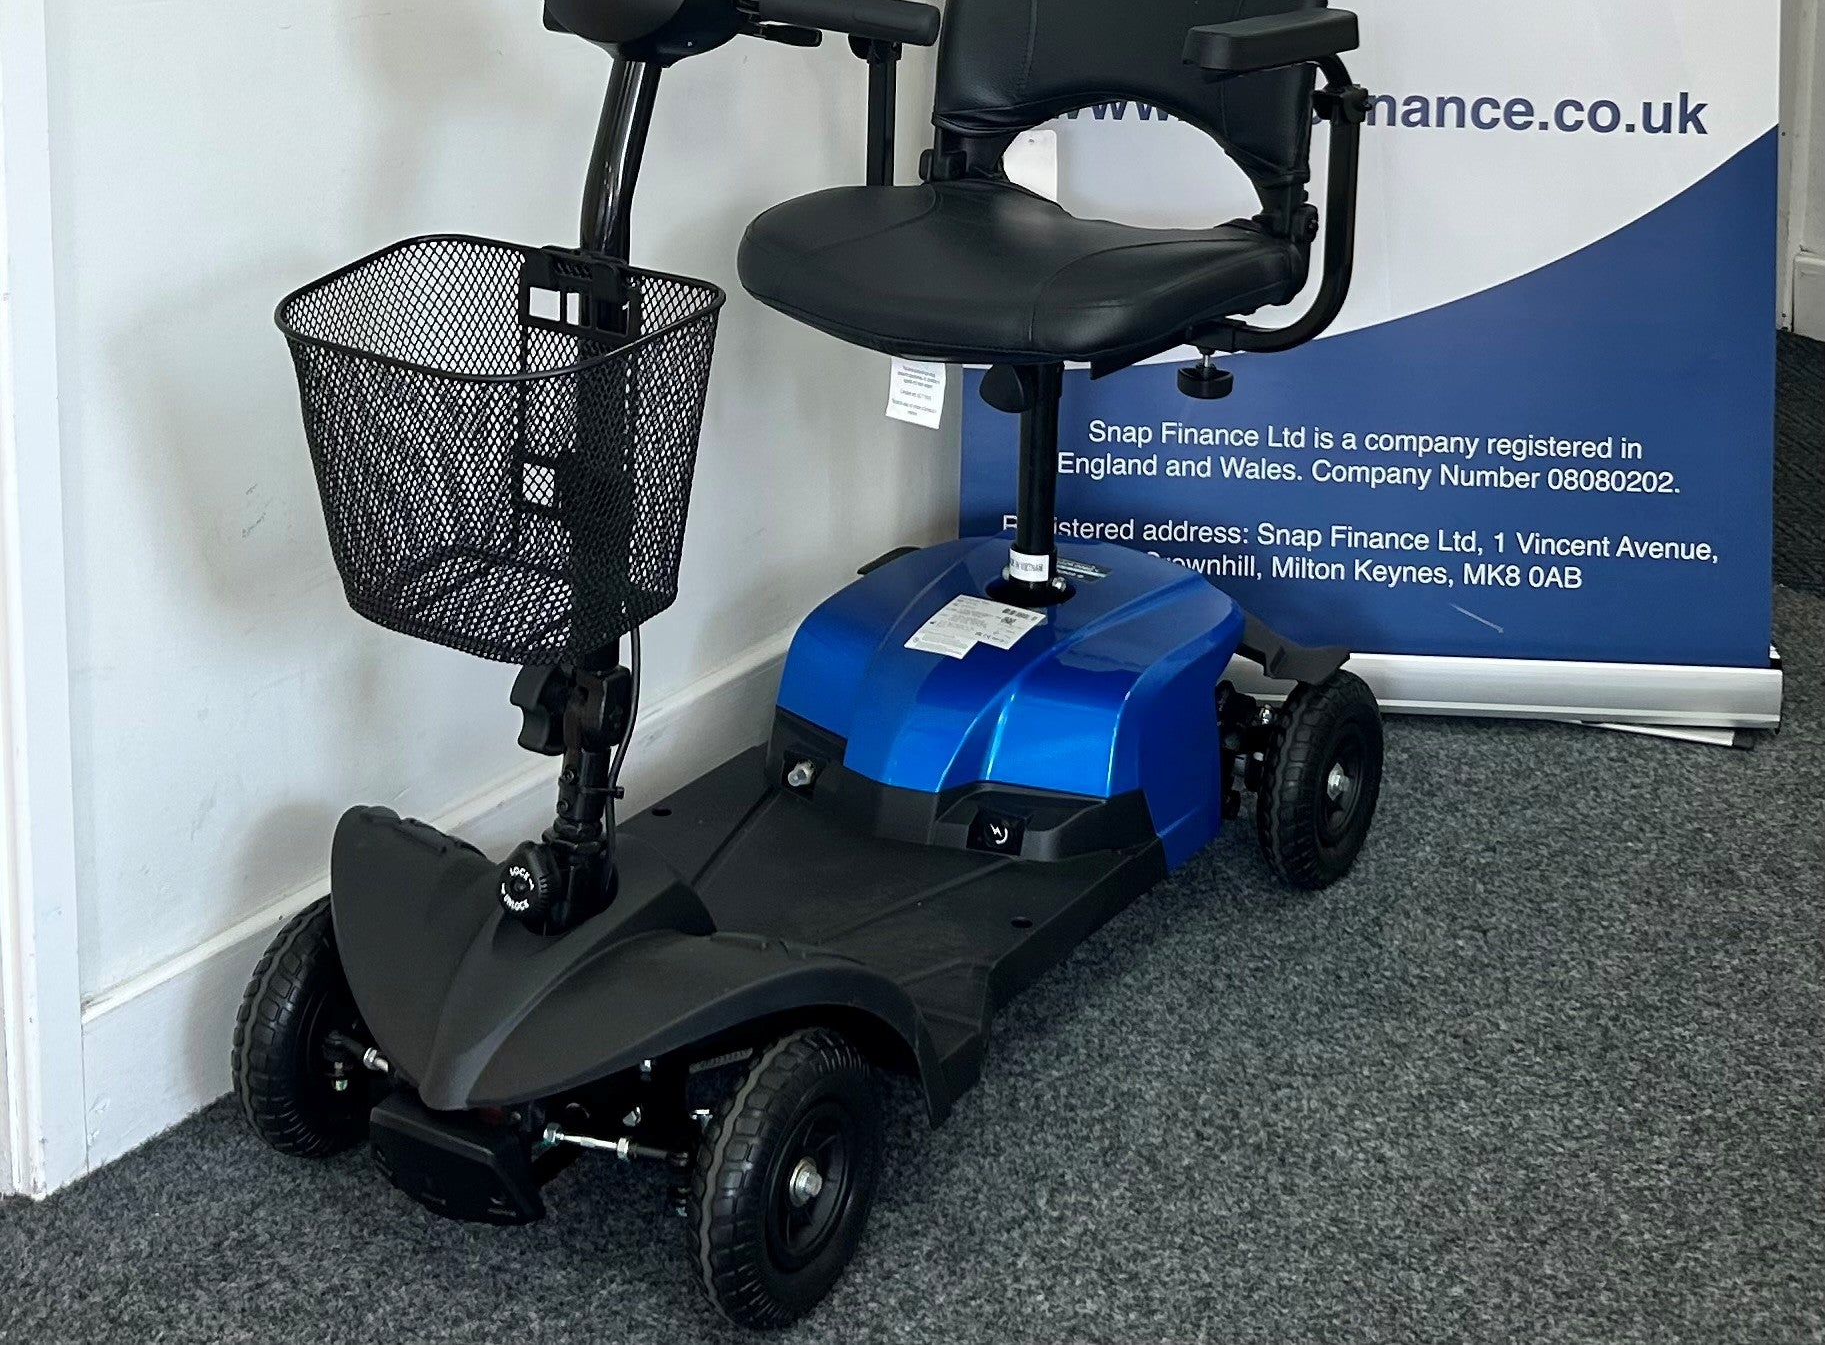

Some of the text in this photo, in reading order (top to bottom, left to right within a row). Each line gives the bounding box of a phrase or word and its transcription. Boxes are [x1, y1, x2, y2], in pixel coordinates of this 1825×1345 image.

[1089, 420, 1641, 462] Snap Finance Ltd is a company registered in
[1058, 452, 1679, 492] England and Wales. Company Number 08080202.
[1004, 515, 1719, 563] Ristered address: Snap Finance Ltd, 1 Vincent Avenue,
[1273, 556, 1344, 580] Milton
[1355, 559, 1453, 587] Keynes,
[1464, 563, 1520, 586] MK8
[1528, 566, 1583, 589] 0AB
[510, 867, 530, 880] LOCK
